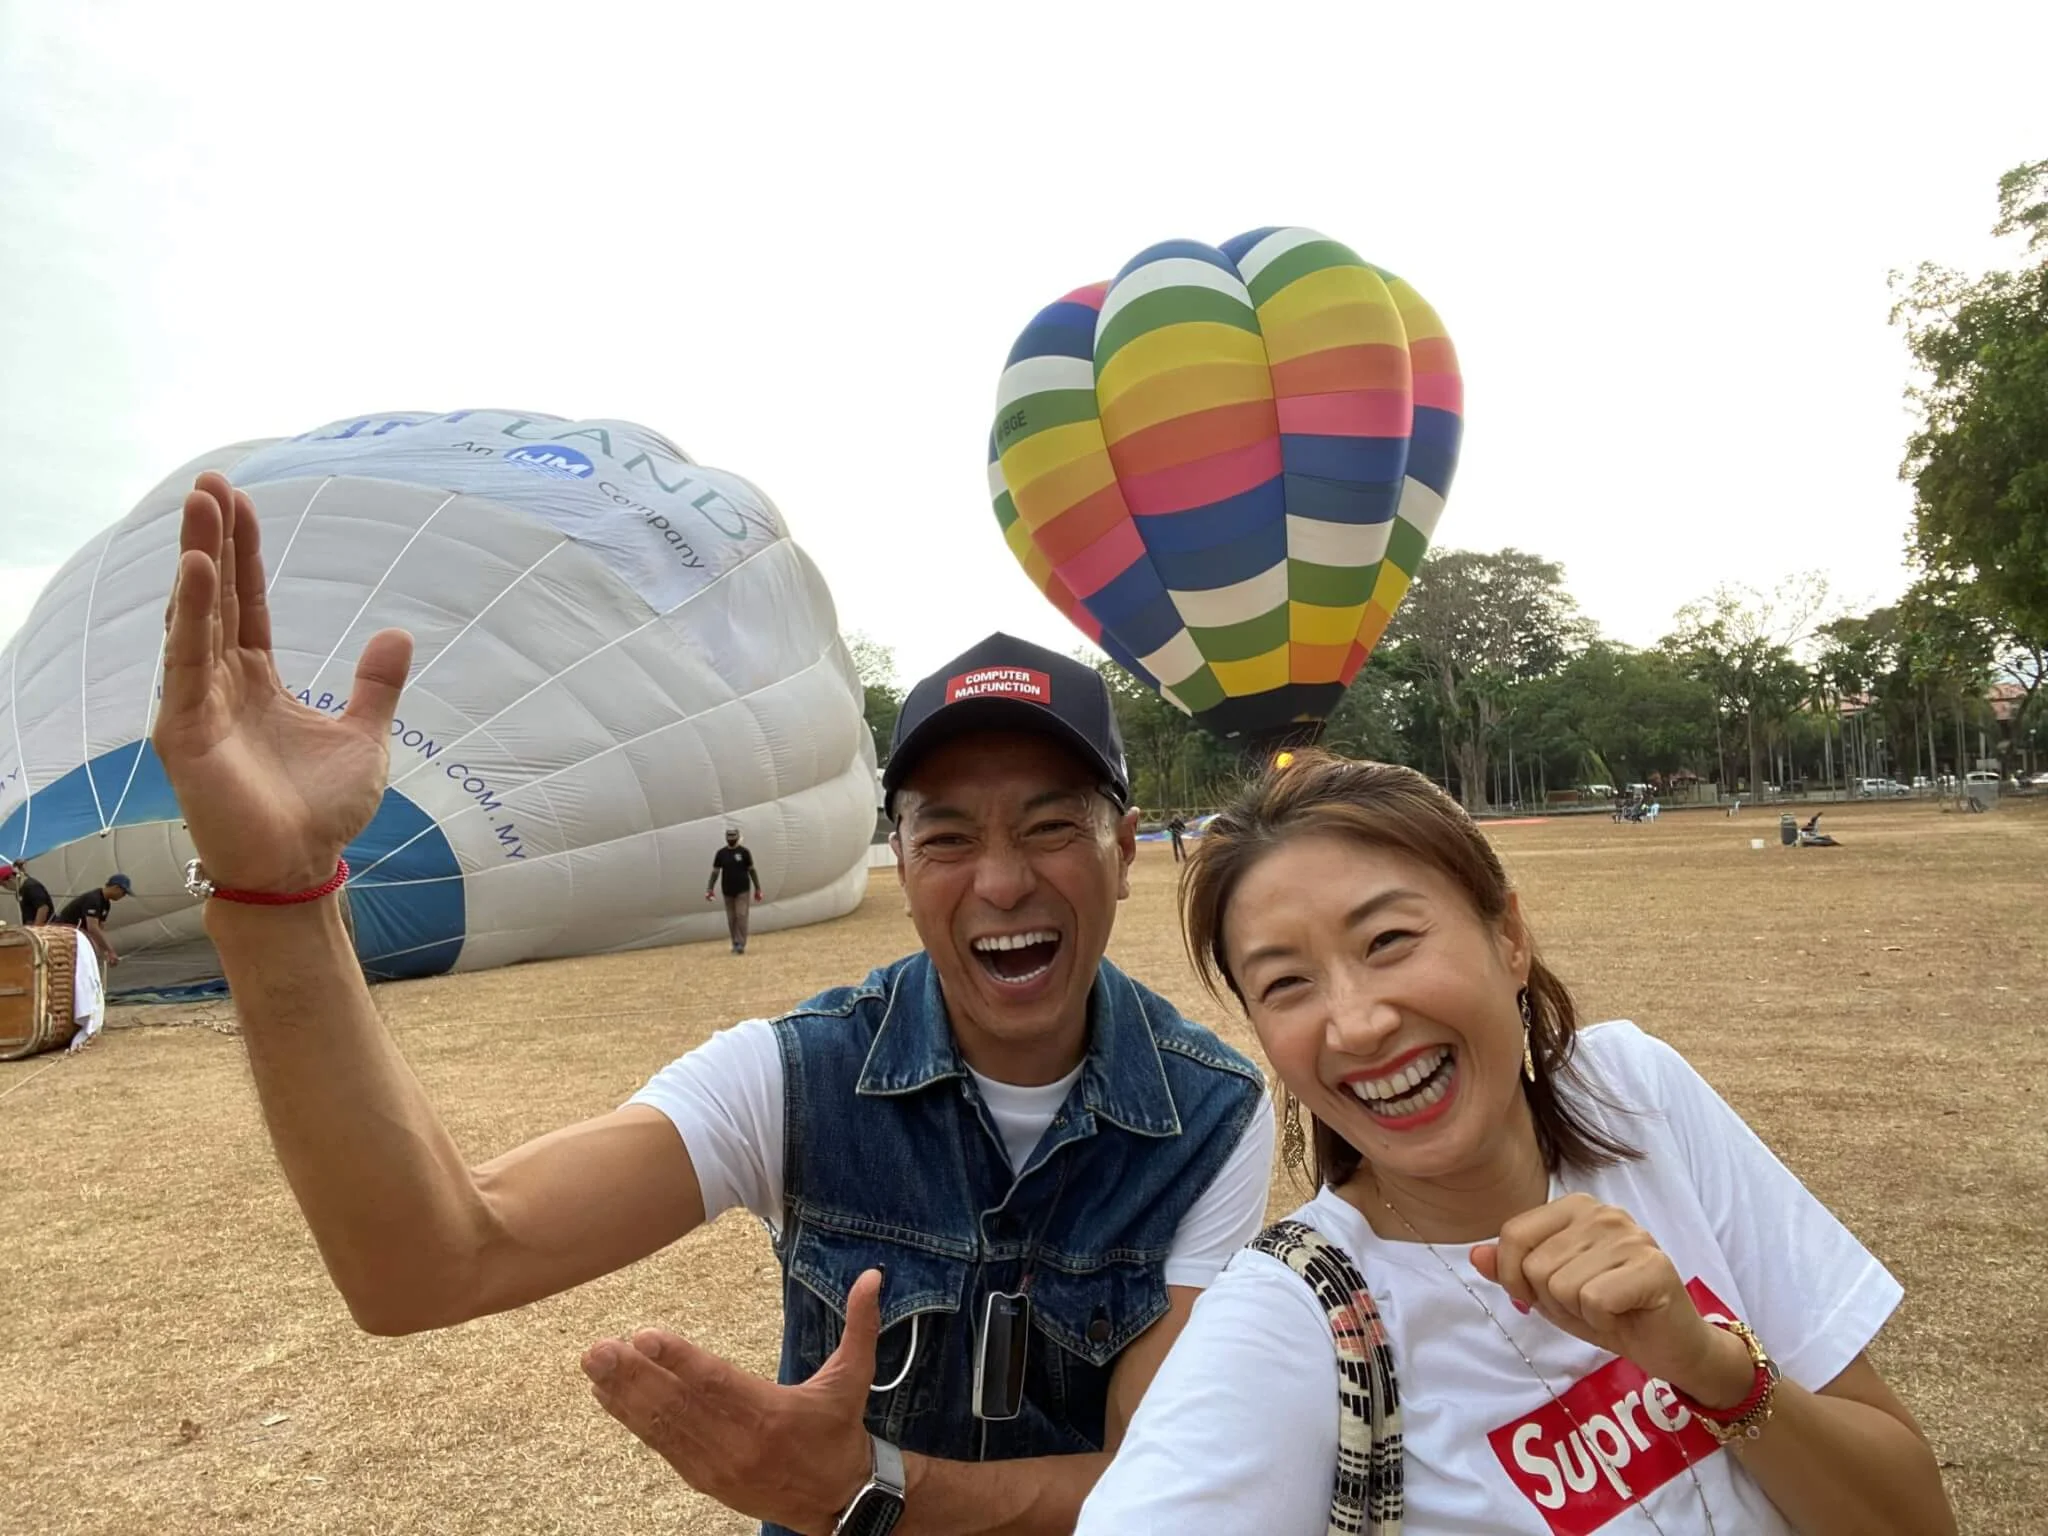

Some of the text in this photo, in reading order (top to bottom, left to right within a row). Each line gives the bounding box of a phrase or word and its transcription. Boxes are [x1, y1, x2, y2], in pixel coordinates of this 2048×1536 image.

[451, 440, 706, 570] An IJM Company
[501, 420, 748, 541] LAND
[954, 681, 1041, 699] MALFUNCTION
[965, 670, 1030, 684] COMPUTER
